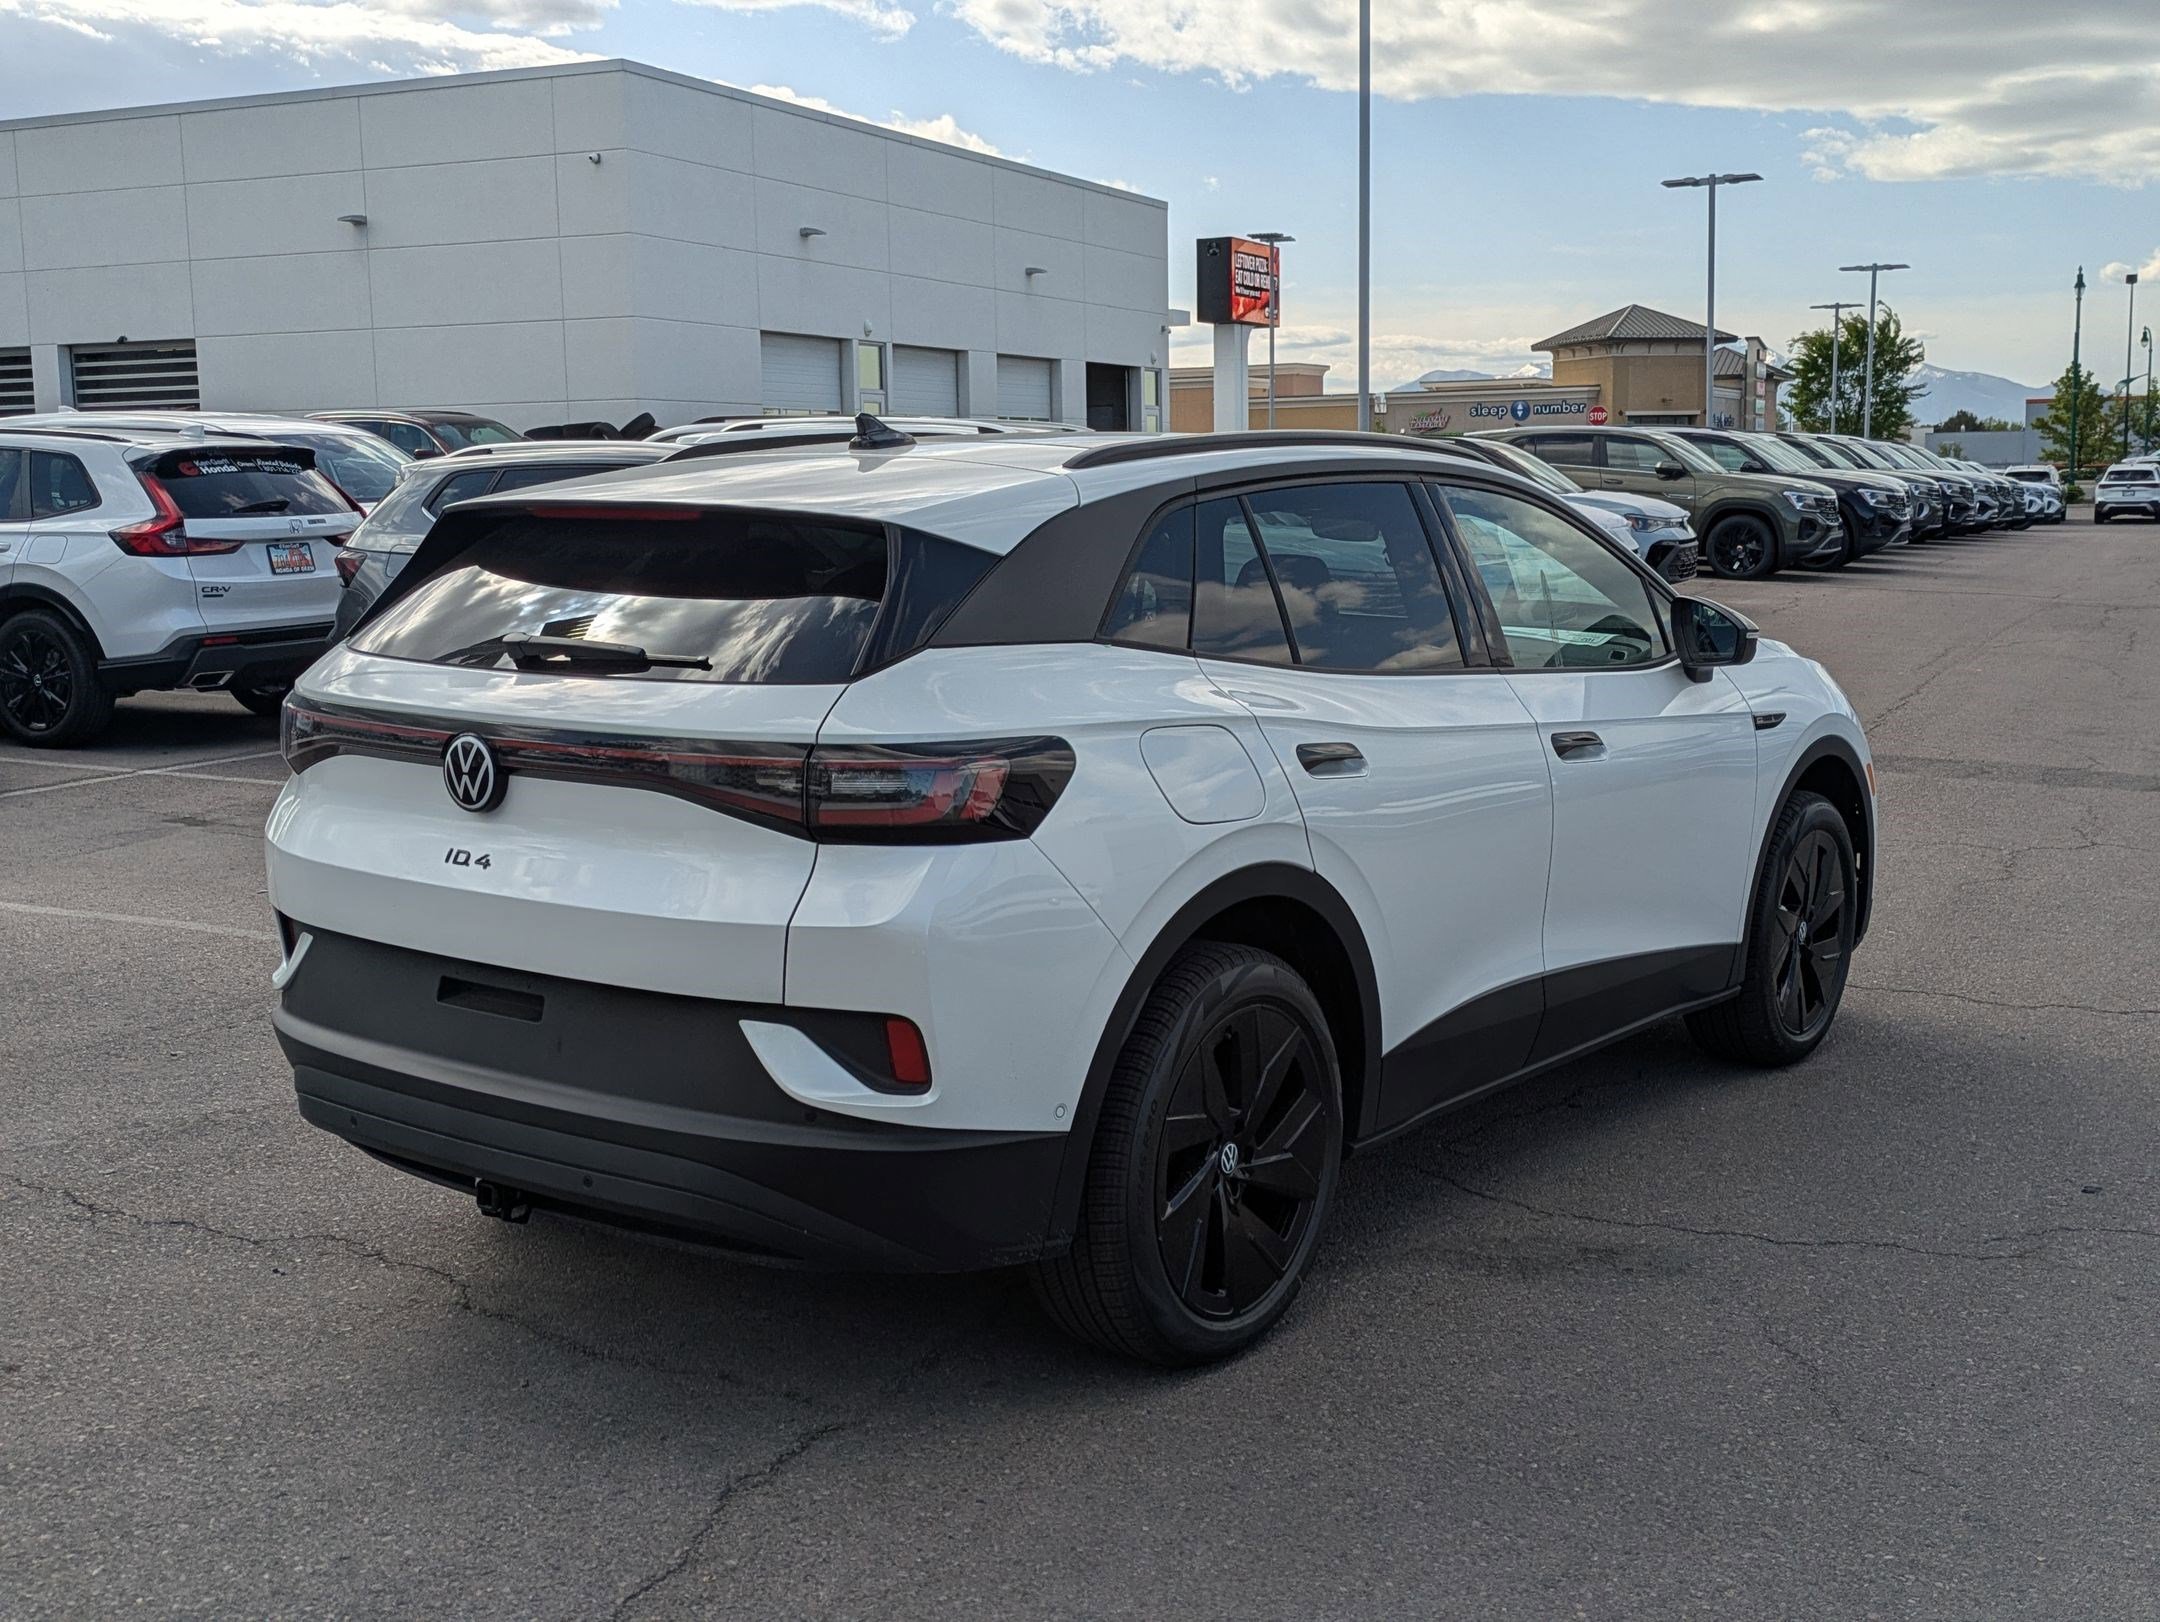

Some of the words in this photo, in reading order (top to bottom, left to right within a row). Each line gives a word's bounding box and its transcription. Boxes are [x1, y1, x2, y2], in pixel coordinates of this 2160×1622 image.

[1235, 253, 1255, 271] LEFTOVER
[1235, 269, 1243, 284] EAT
[1243, 270, 1254, 286] COLD
[1254, 273, 1261, 288] OR
[1470, 404, 1508, 420] sleep
[1533, 400, 1587, 415] number
[1589, 412, 1608, 421] STOP
[199, 464, 238, 475] Honda
